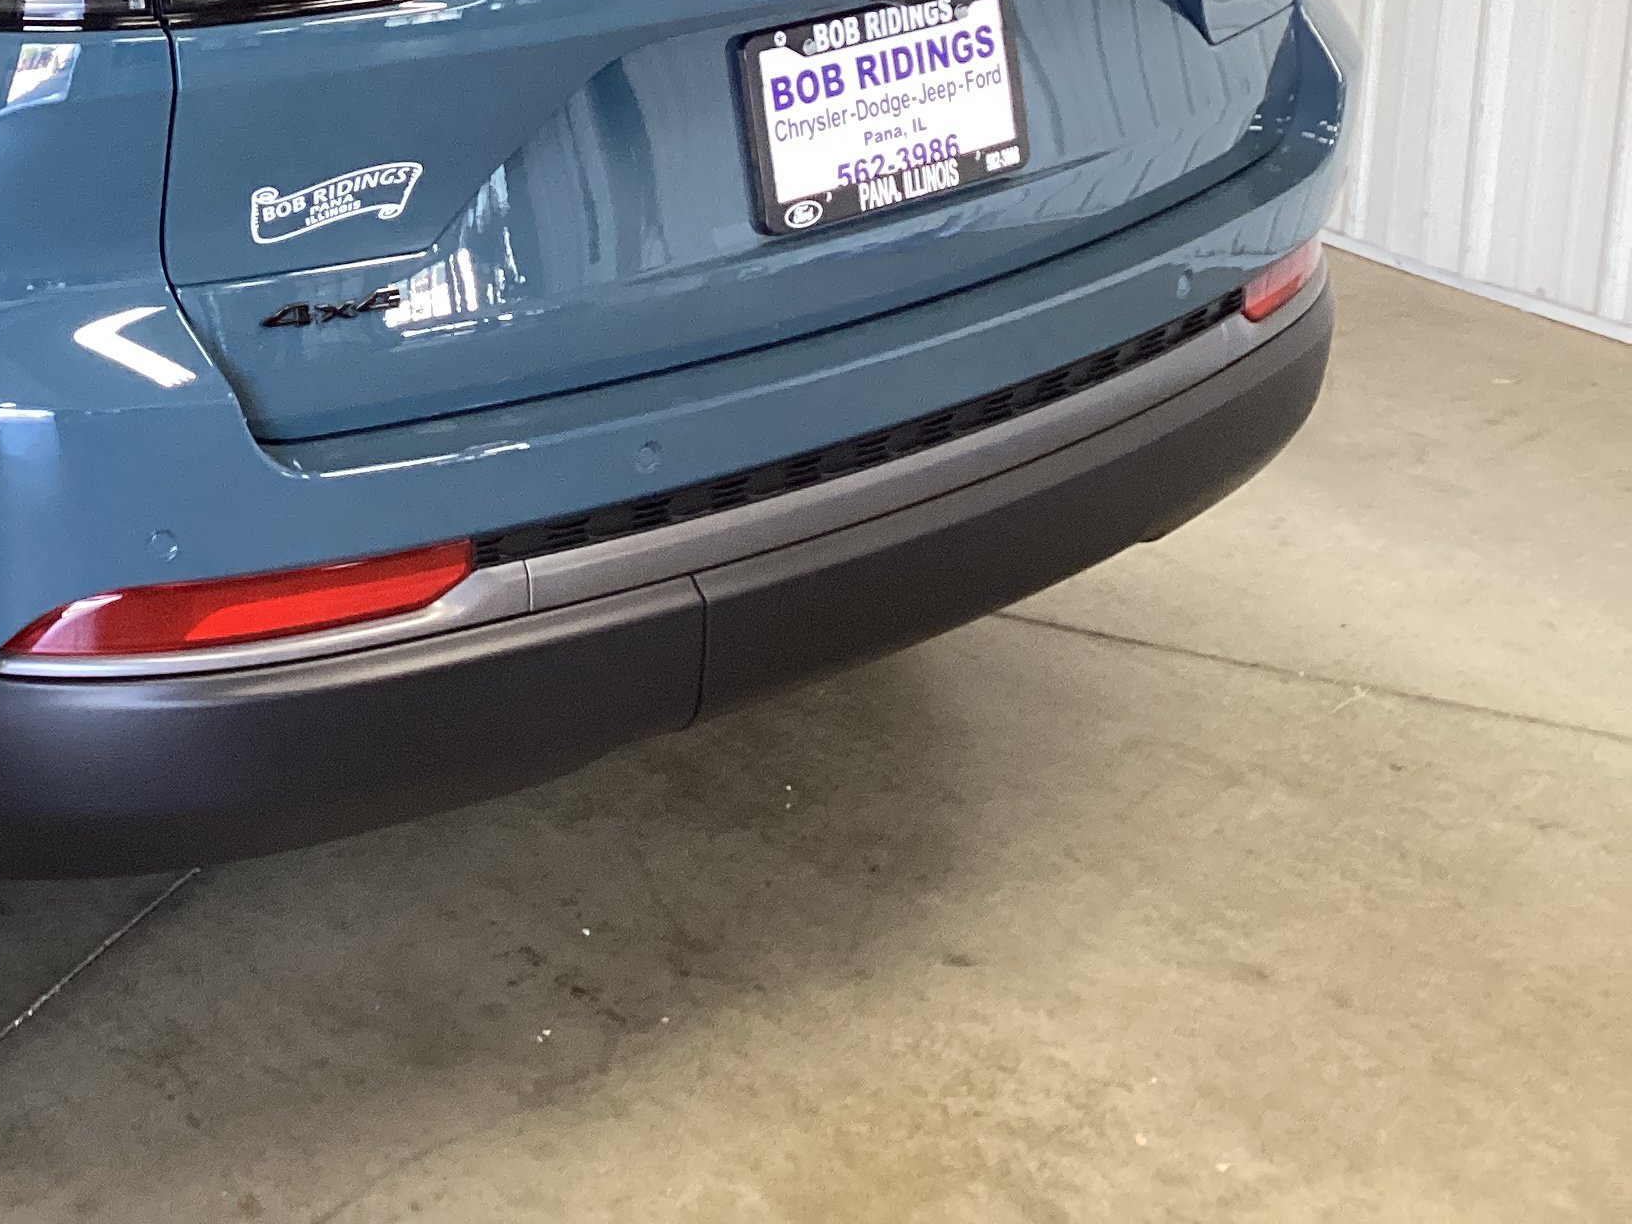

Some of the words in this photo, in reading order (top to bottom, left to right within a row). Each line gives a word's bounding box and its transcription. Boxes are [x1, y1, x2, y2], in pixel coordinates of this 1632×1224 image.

[812, 16, 861, 53] BOB
[770, 62, 846, 113] BOB
[855, 25, 996, 91] RIDINGS
[774, 63, 1003, 143] Chrysler-Dodge-Jeep-Ford
[863, 126, 908, 147] Pana,
[912, 117, 928, 134] IL
[837, 133, 961, 187] 562-3986
[903, 158, 960, 199] ILLINOIS
[261, 196, 307, 223] BOB
[313, 167, 411, 205] RIDINGS
[310, 193, 355, 216] PANA
